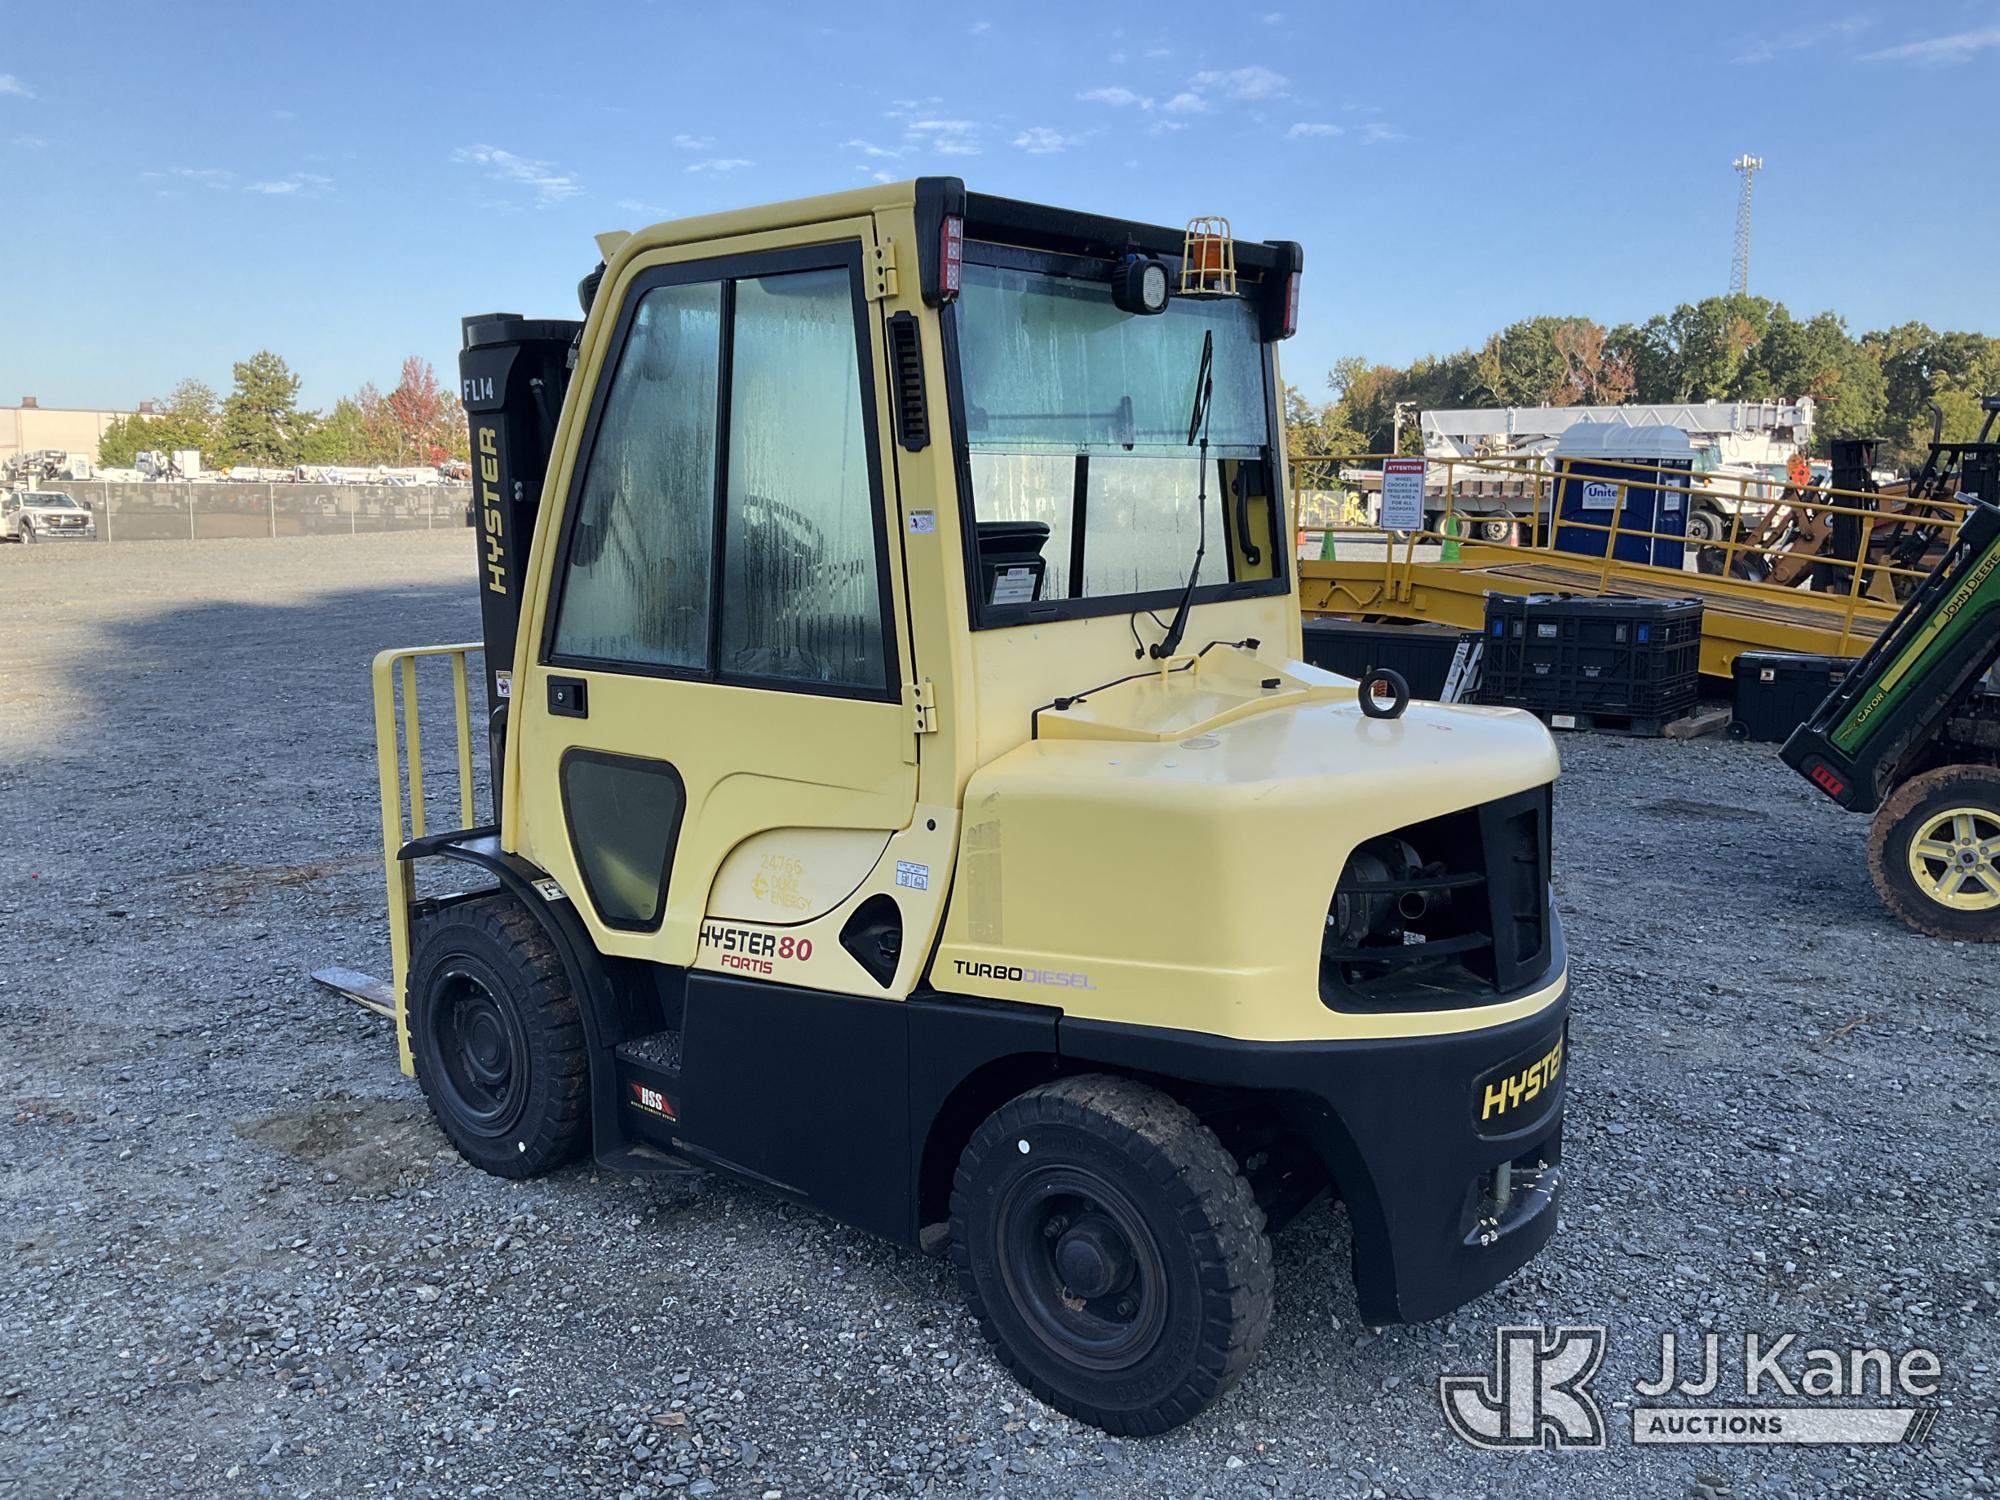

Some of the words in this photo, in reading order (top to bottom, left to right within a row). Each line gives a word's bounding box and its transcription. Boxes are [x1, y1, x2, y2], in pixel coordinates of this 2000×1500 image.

[1588, 488, 1618, 497] Unite
[478, 427, 507, 595] HYSTER
[1942, 589, 1971, 619] JOHN
[1964, 551, 1999, 590] DEERE
[1857, 692, 1884, 722] GATOR
[778, 936, 813, 961] 80
[721, 954, 773, 974] FORTIS
[641, 1087, 663, 1110] HSS
